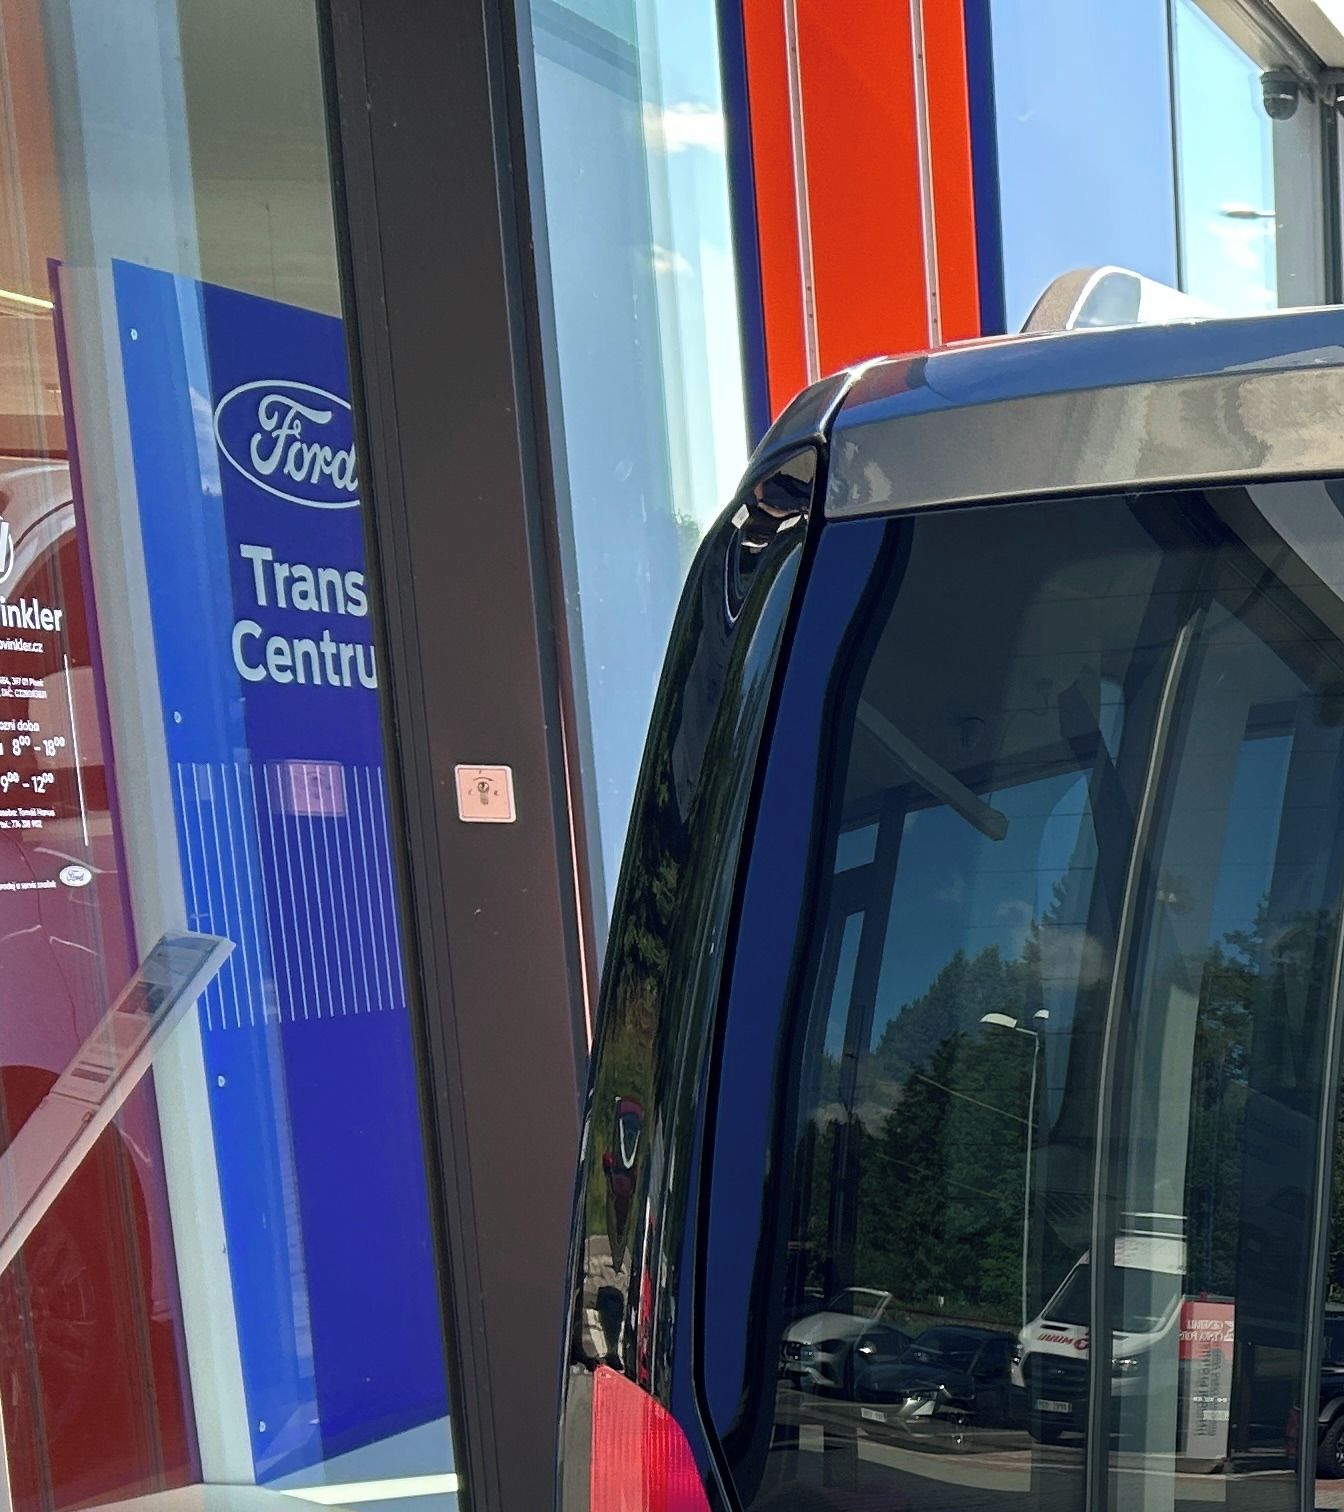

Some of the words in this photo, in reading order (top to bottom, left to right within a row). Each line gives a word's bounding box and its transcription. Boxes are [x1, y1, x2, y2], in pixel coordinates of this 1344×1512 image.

[251, 393, 359, 490] Ford
[240, 544, 367, 617] Trans
[231, 620, 378, 690] Centru
